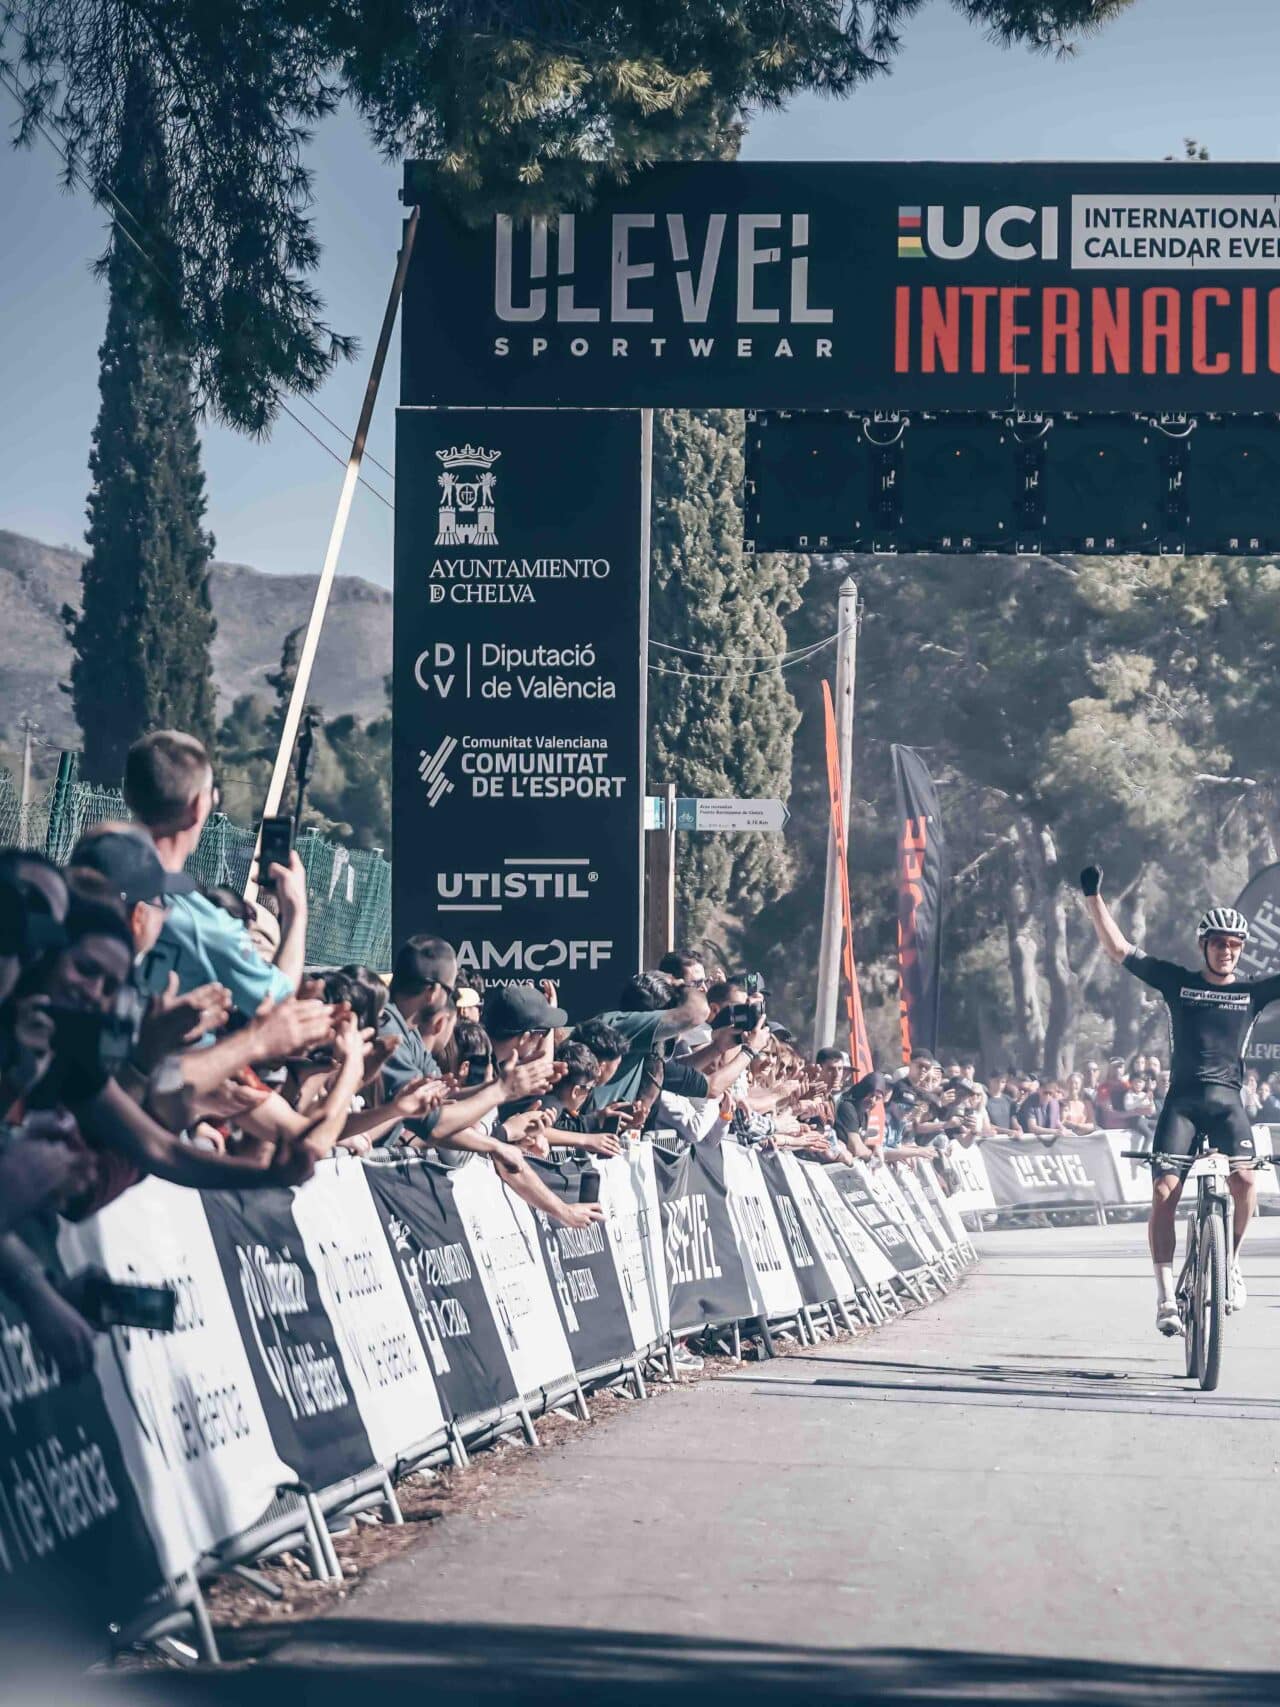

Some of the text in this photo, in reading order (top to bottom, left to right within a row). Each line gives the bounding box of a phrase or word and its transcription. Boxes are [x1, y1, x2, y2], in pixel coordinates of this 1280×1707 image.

[927, 205, 1059, 261] UCI
[1084, 237, 1221, 259] CALENDAR
[495, 213, 833, 323] ULEVEL
[494, 337, 833, 358] SPORTWEAR
[428, 557, 611, 579] AYUNTAMIENTO
[450, 583, 537, 604] CHELVA
[482, 642, 596, 671] Diputació
[481, 675, 616, 699] de València
[462, 735, 608, 749] Comunitat Valenciana
[461, 752, 608, 774] COMUNITAT
[472, 776, 627, 798] DE L'ESPORT
[456, 939, 614, 972] AMOFF
[484, 977, 535, 989] LWAYS
[1009, 1153, 1096, 1188] ULEVEL
[1207, 1158, 1218, 1169] 3
